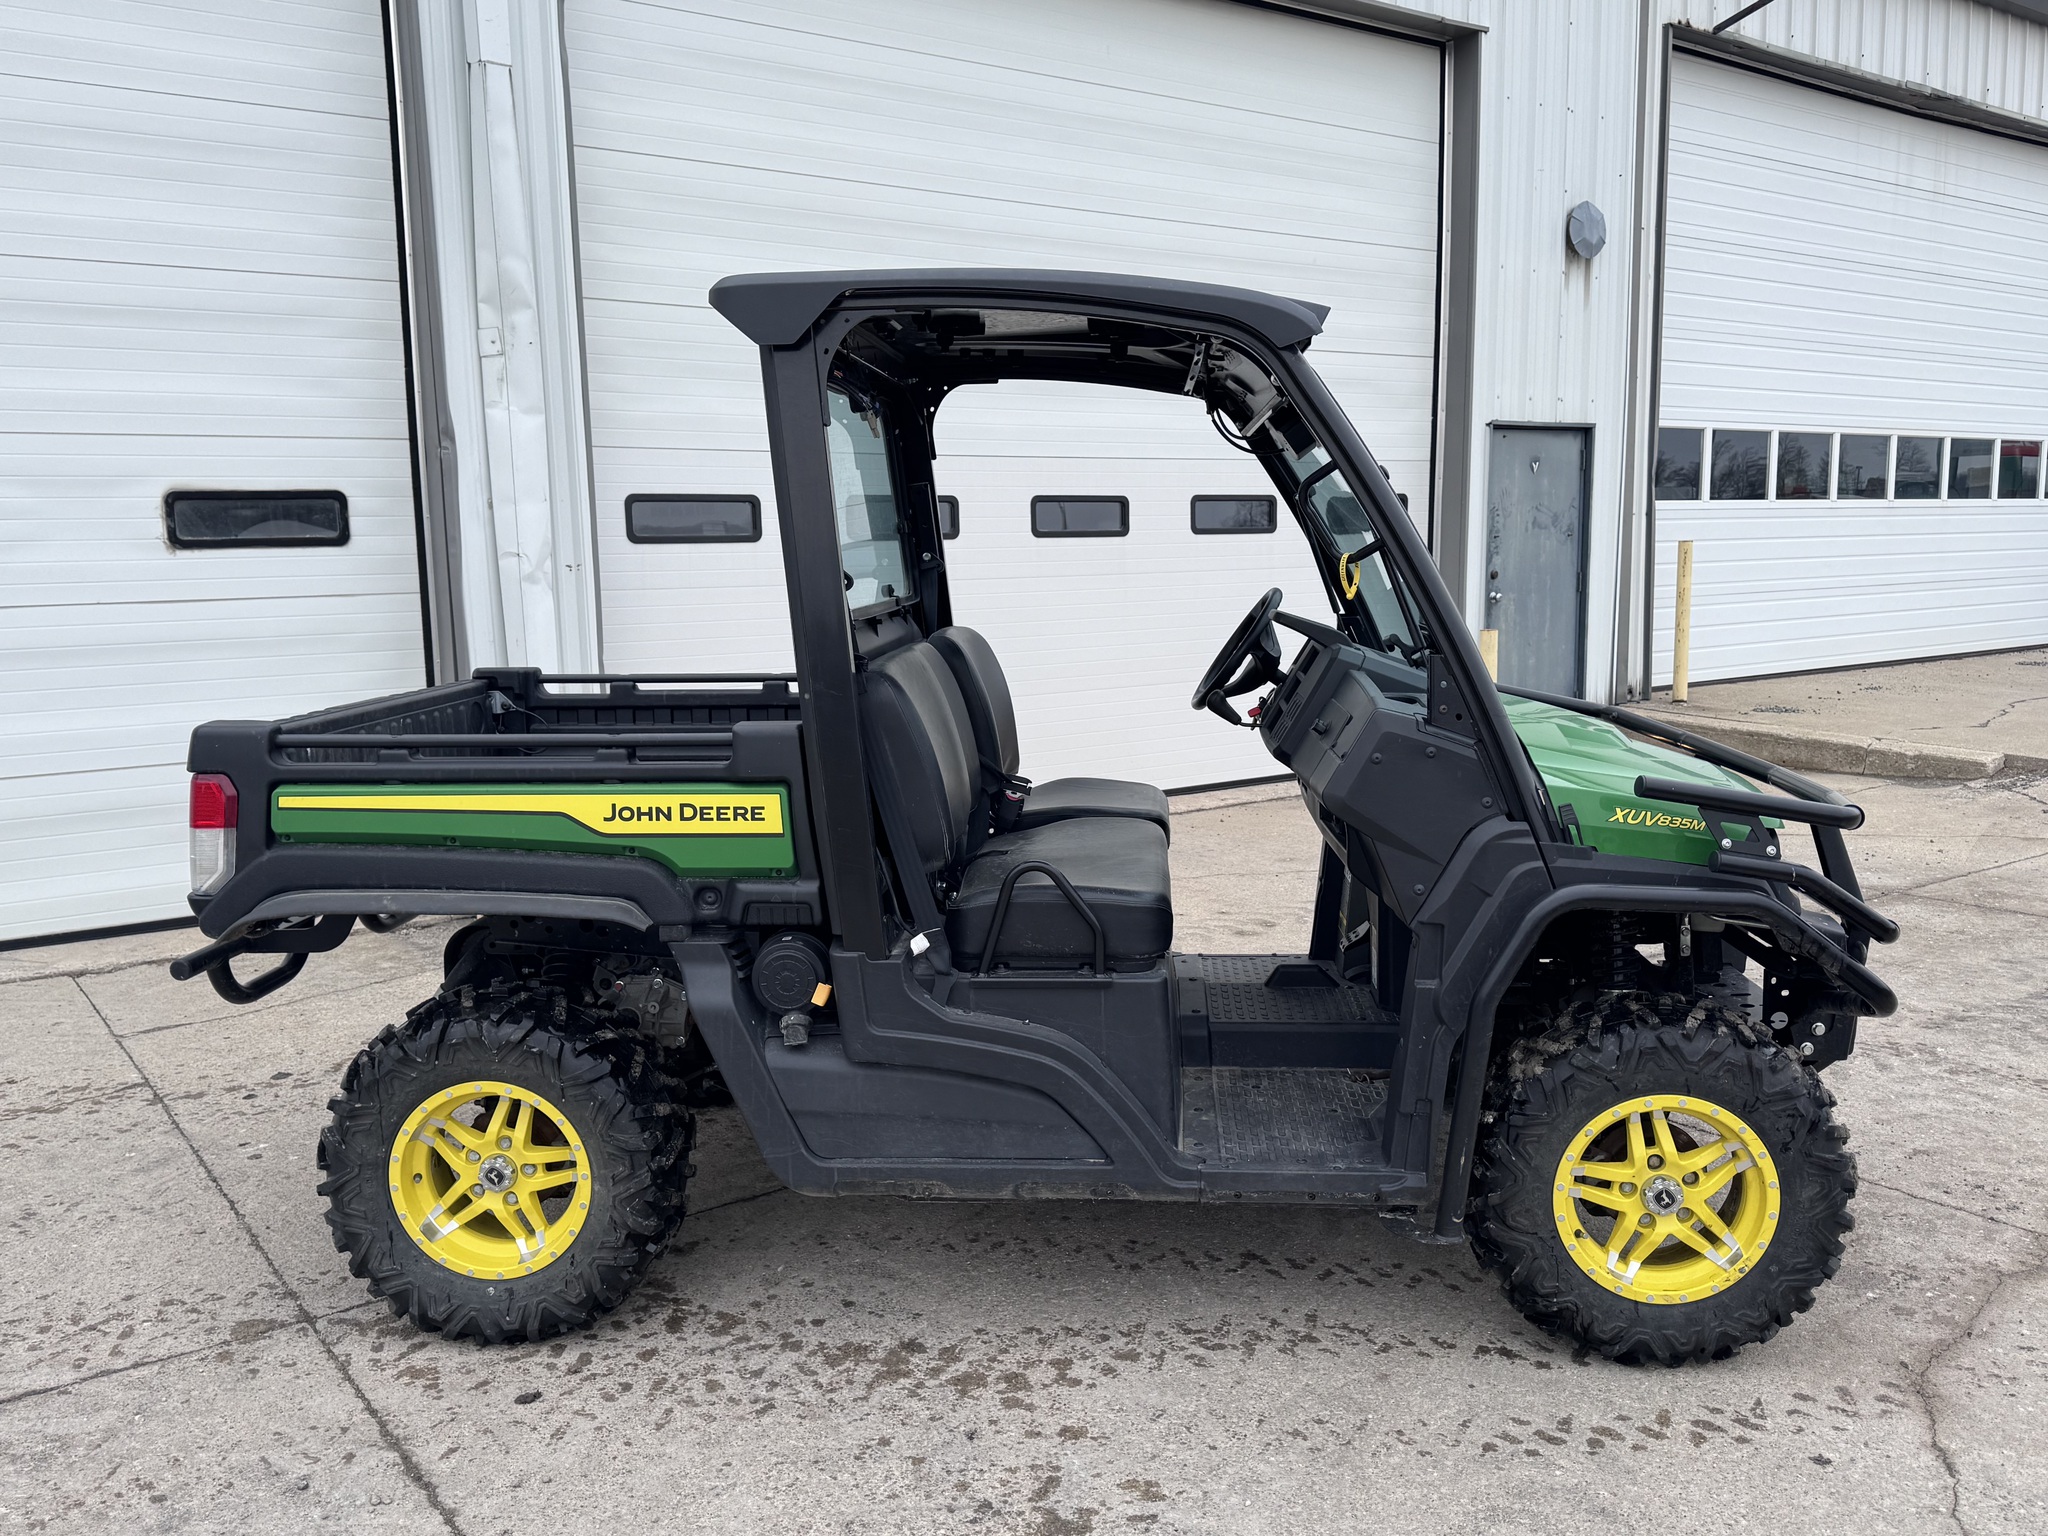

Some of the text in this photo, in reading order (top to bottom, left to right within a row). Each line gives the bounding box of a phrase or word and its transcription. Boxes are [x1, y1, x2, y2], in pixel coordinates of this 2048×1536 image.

[603, 803, 766, 822] JOHN DEERE
[1607, 806, 1707, 832] XUV835M
